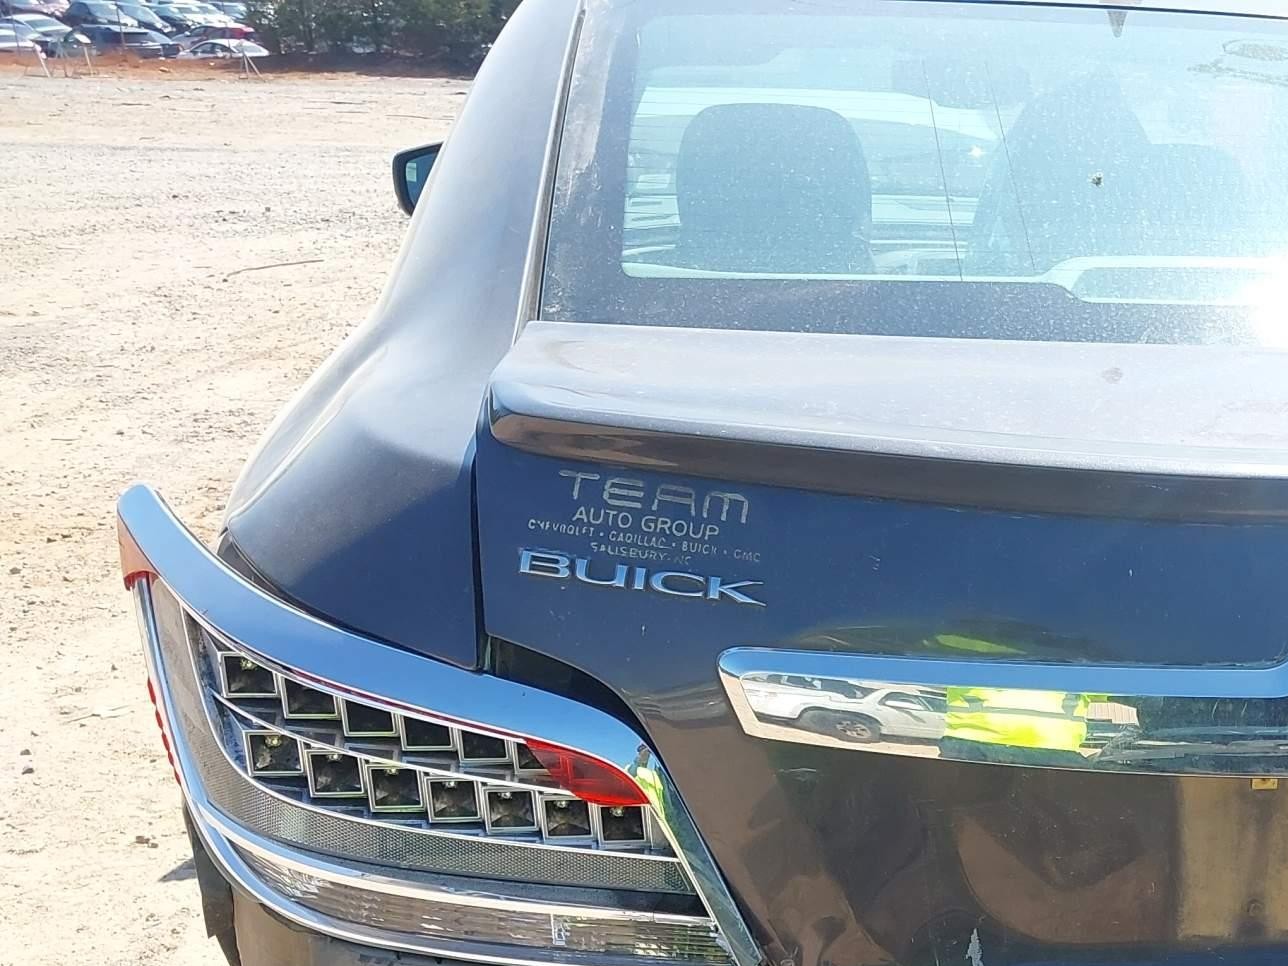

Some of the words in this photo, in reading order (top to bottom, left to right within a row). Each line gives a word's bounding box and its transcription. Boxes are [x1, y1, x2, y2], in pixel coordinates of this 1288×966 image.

[559, 470, 749, 523] TEAM
[572, 506, 632, 529] AUTO
[641, 516, 720, 540] GROUP
[609, 530, 668, 548] CADILLAC
[682, 541, 717, 555] BUICK
[734, 549, 761, 562] GMC
[519, 550, 767, 607] BUICK
